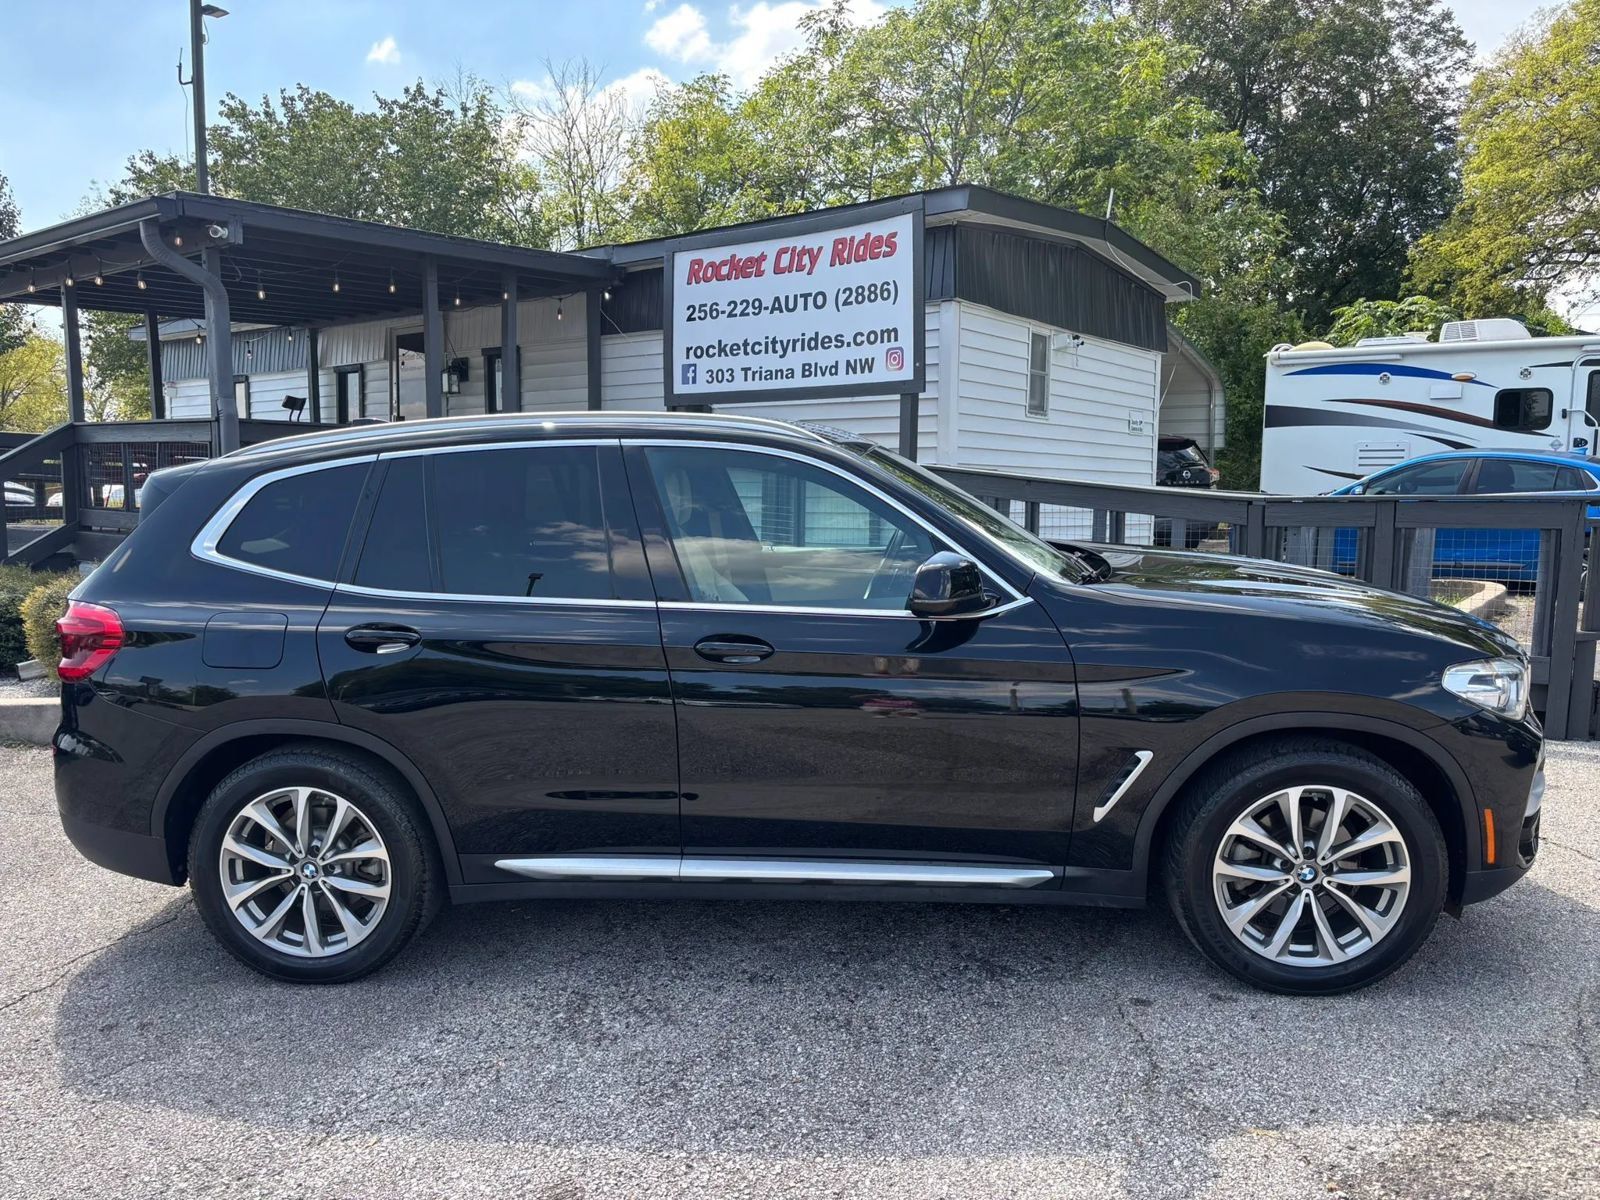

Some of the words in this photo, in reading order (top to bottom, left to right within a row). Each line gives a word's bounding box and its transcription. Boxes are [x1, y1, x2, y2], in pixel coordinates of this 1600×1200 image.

[687, 251, 767, 285] Rocket
[773, 245, 824, 275] City
[829, 231, 898, 267] Rides
[686, 291, 827, 322] 256-229-AUTO
[835, 280, 899, 312] (2886)
[686, 327, 899, 359] rocketcityrides.com
[705, 367, 735, 384] 303
[740, 366, 795, 382] Triana
[801, 360, 839, 378] Blvd
[845, 357, 875, 375] NW
